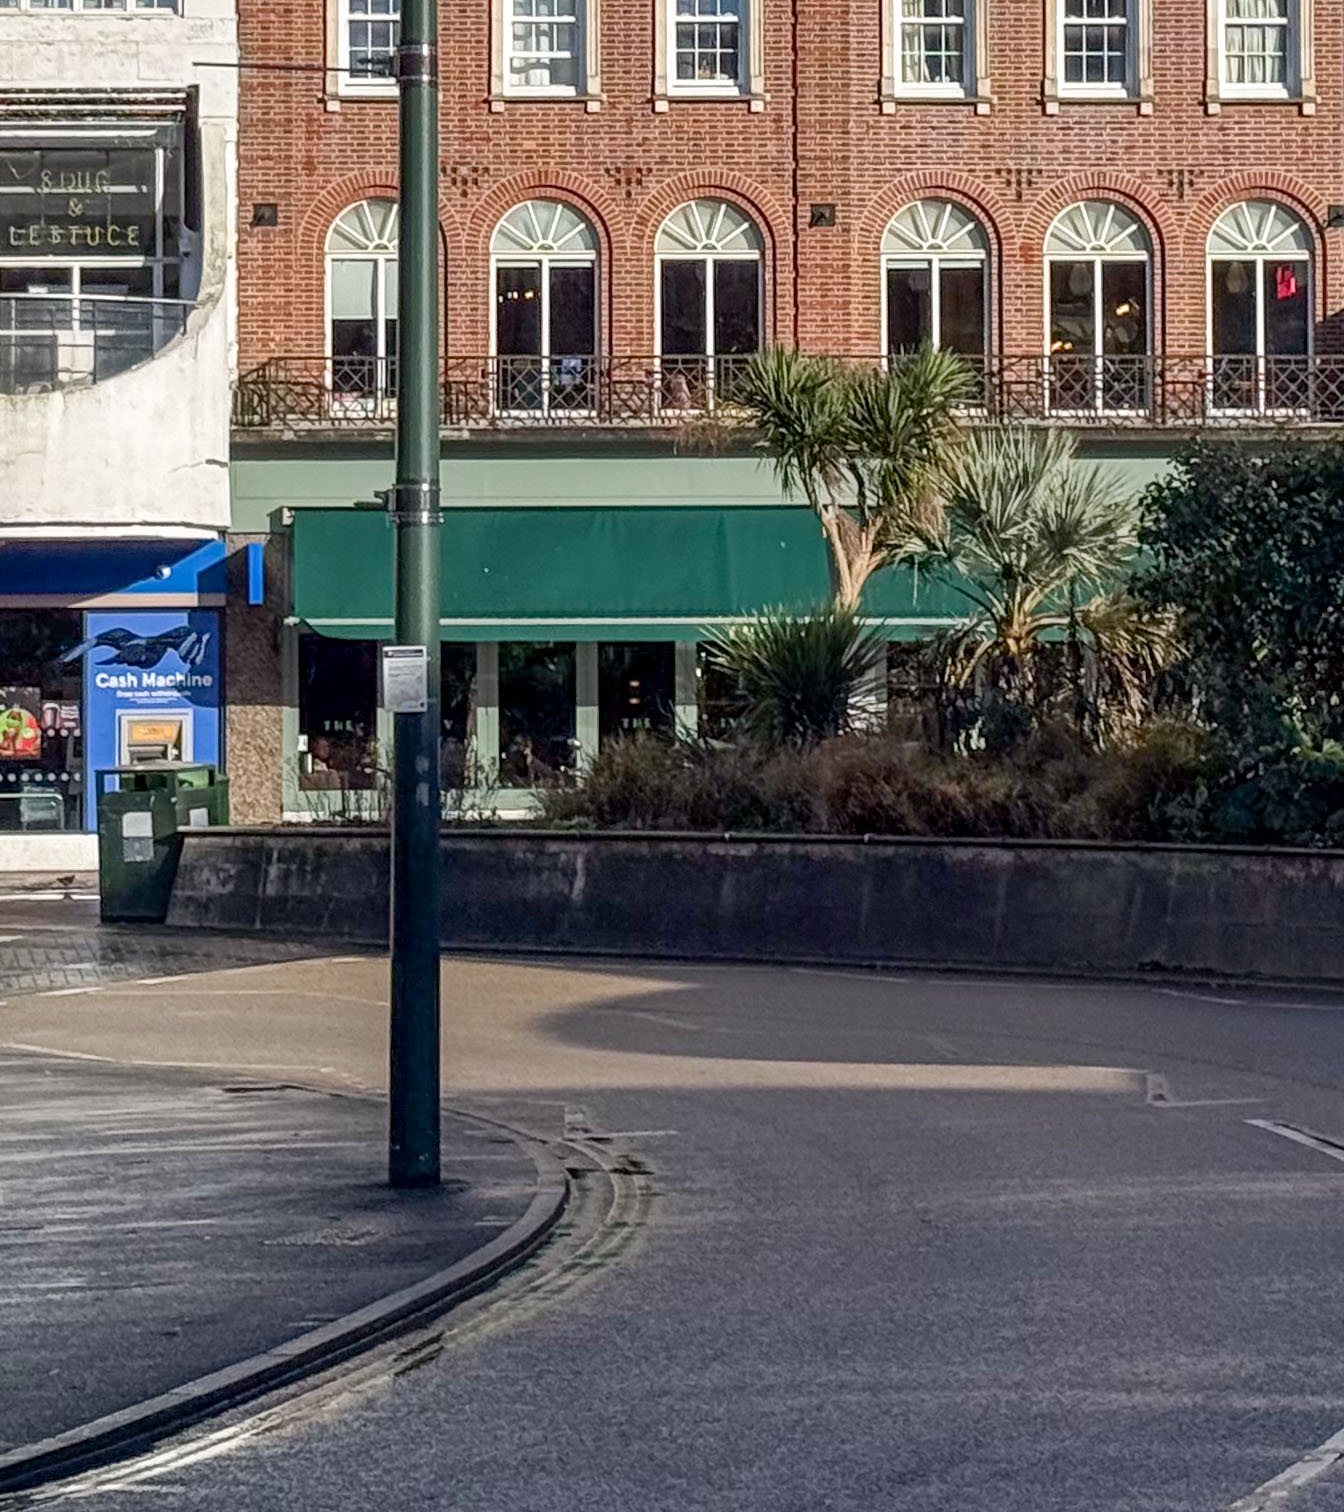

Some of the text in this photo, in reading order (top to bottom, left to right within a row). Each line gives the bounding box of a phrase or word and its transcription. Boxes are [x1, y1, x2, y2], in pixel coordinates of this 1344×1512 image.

[68, 198, 83, 217] &
[9, 225, 140, 246] LETTUCE
[96, 672, 213, 688] Cash Machine
